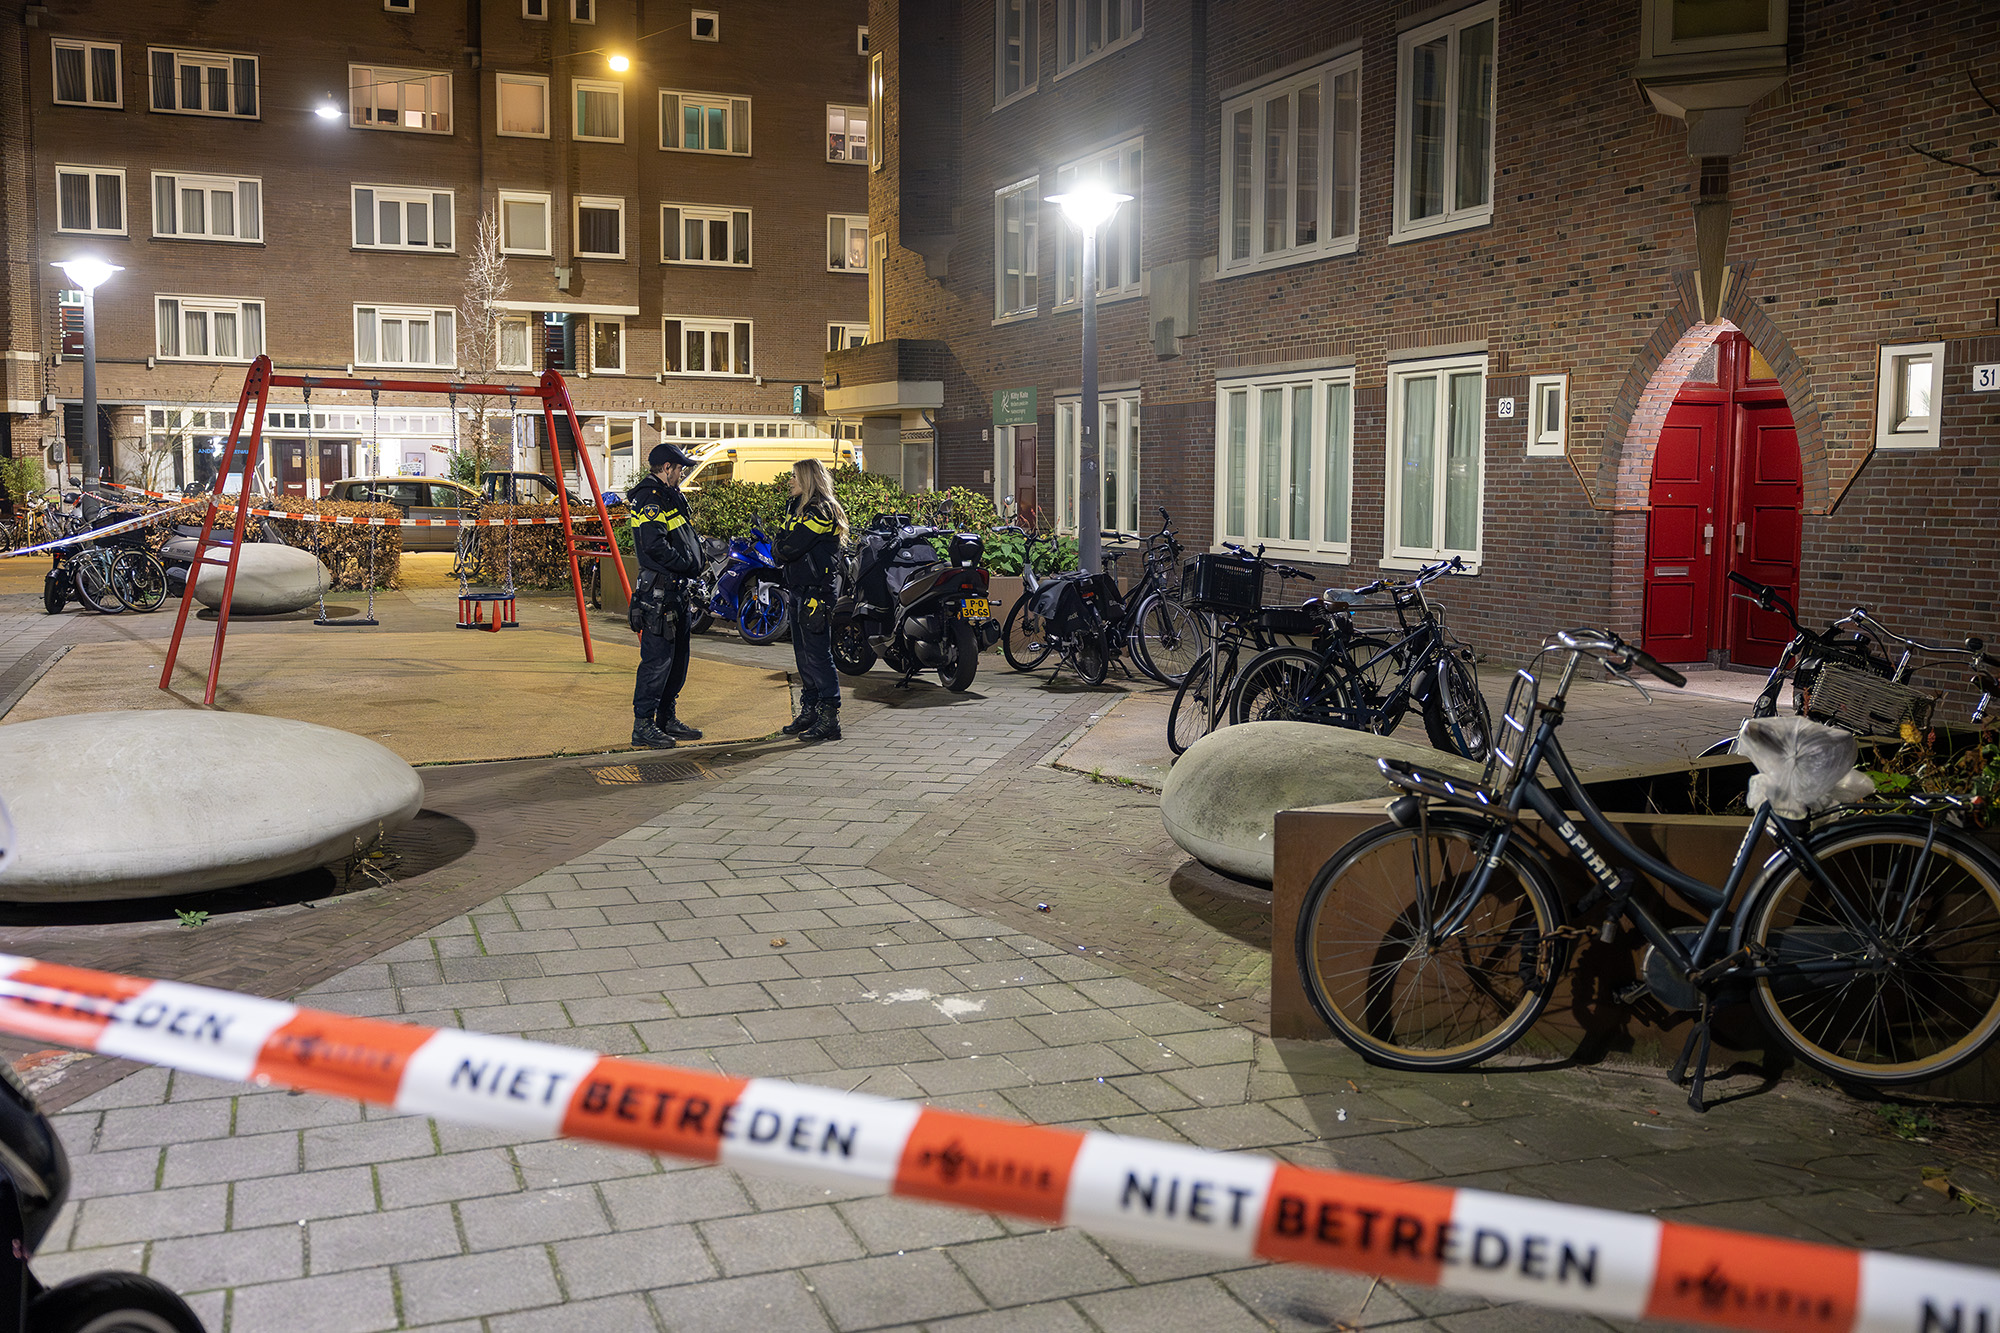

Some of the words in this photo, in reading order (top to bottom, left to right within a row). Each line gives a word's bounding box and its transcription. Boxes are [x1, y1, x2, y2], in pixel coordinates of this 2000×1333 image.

[1980, 369, 1995, 386] 31
[1500, 401, 1511, 414] 29
[450, 1058, 566, 1105] NIET
[581, 1079, 859, 1157] BETREDEN
[1120, 1169, 1253, 1229] NIET
[1274, 1196, 1598, 1287] BETREDEN
